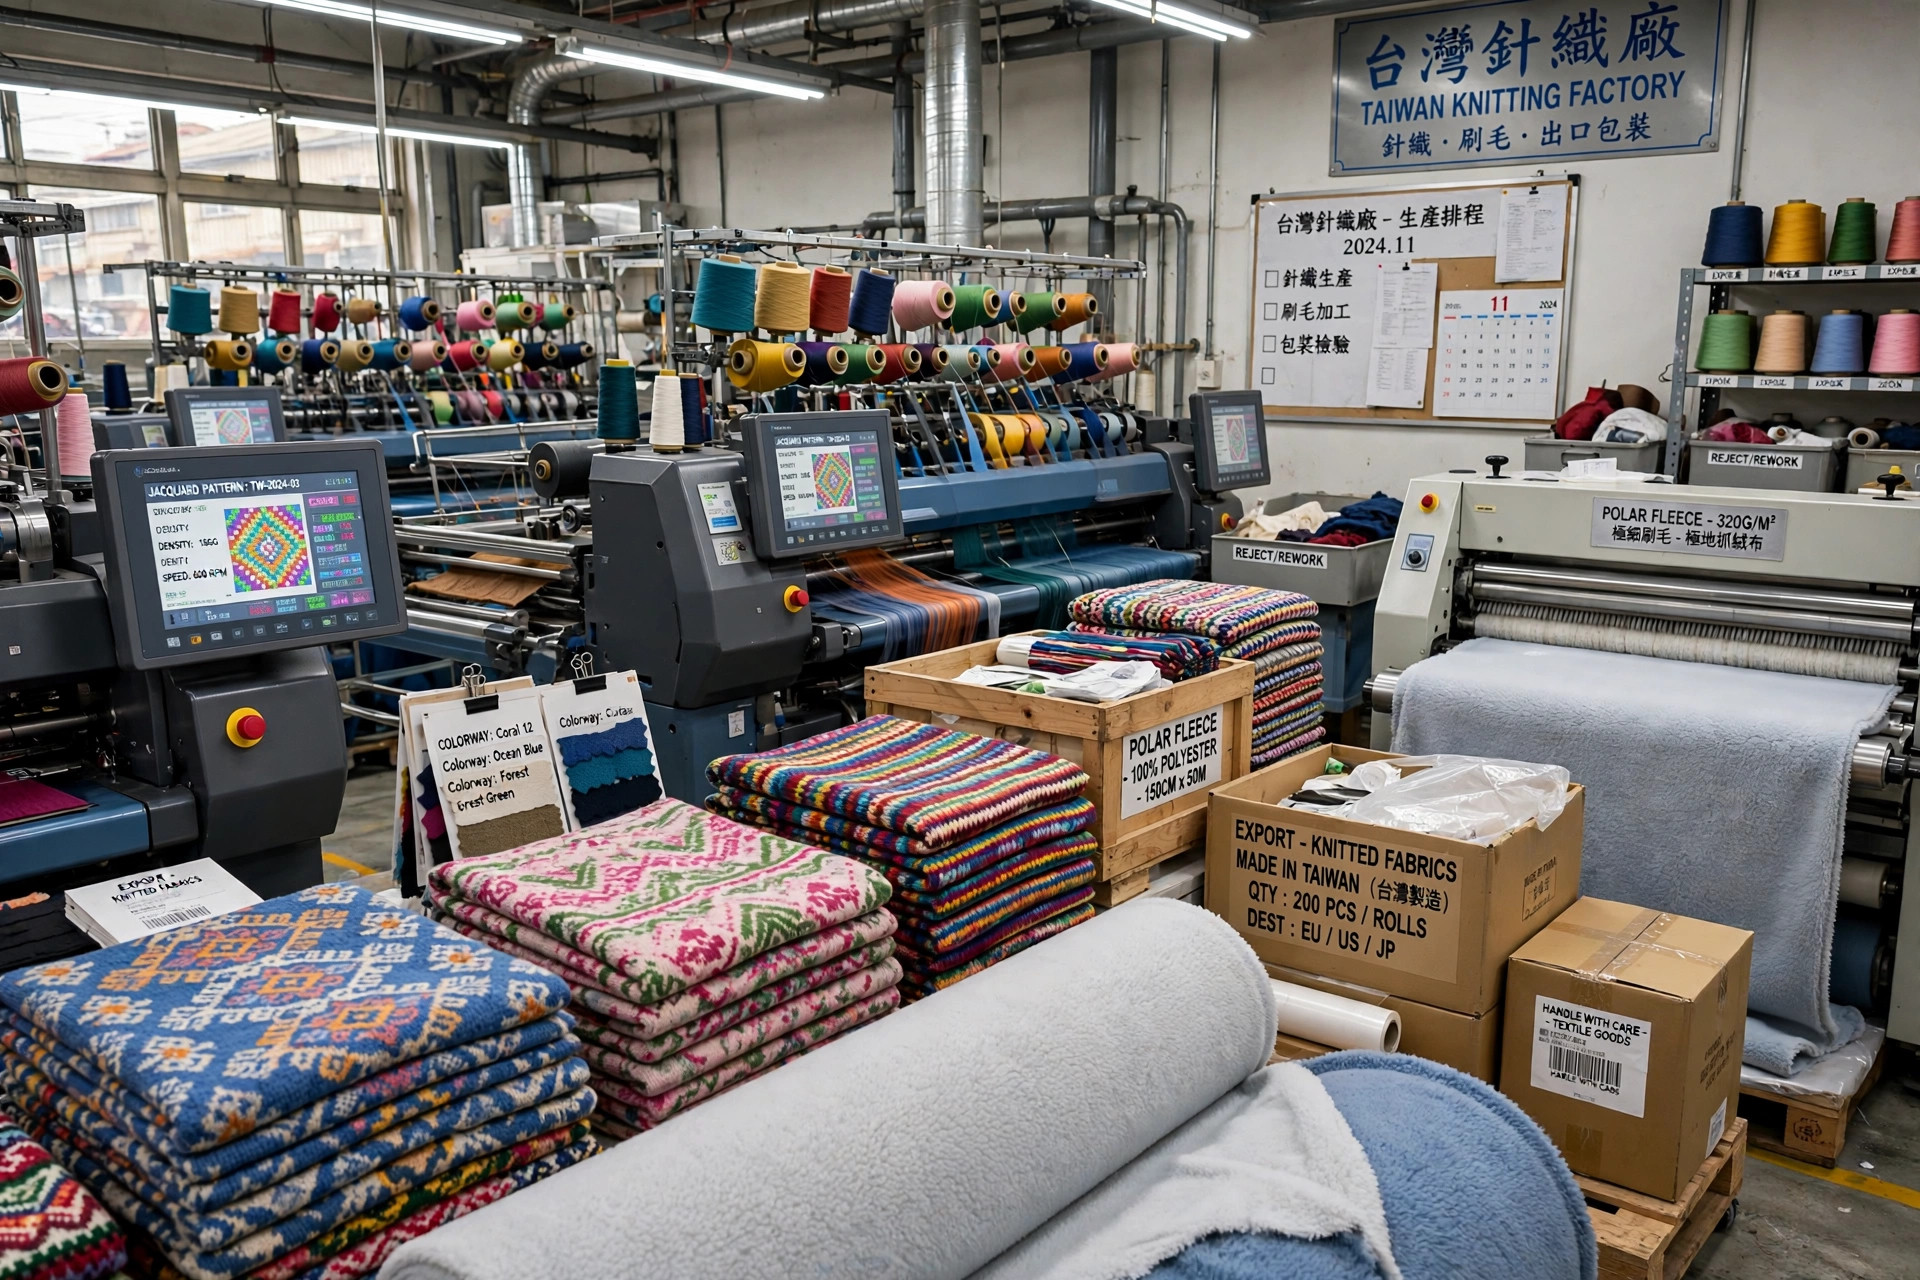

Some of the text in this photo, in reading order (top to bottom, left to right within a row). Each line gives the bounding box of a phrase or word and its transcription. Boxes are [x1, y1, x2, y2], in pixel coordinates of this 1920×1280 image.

[1365, 1, 1686, 92] 台灣針織廠
[1361, 70, 1687, 126] TAIWAN KNITTING FACTORY
[1399, 203, 1485, 229] 生產排程
[1343, 236, 1415, 255] 2024.11
[1283, 267, 1353, 289] 針織生產
[1281, 301, 1351, 322] 刷毛加工
[1491, 295, 1557, 312] 11 2024
[1280, 334, 1350, 355] 包裝檢驗
[1711, 452, 1800, 468] REJECT/REWORK
[1602, 506, 1647, 523] POLAR
[1652, 509, 1703, 527] FLEECE
[1235, 546, 1324, 567] REJECT/REWORK
[559, 712, 604, 728] Colorway:
[437, 729, 494, 752] COLORWAY:
[496, 726, 521, 740] Coral
[1129, 712, 1217, 760] POLAR FLEECE
[442, 742, 544, 773] Colorway: Ocean Blue
[1130, 757, 1158, 784] 100%
[1160, 738, 1217, 774] POLYESTER
[447, 765, 530, 794] Colorway: Forest
[1144, 775, 1177, 802] 150CM
[1186, 764, 1207, 787] 50M
[486, 788, 515, 804] Green
[1235, 818, 1296, 850] EXPORT
[1311, 834, 1379, 868] KNITTED
[1385, 848, 1458, 884] FABRICS
[1236, 847, 1278, 877] MADE
[1282, 857, 1297, 880] IN
[1302, 862, 1360, 895] TAIWAN
[1248, 880, 1278, 906] QTY
[1293, 890, 1321, 915] 200
[1325, 895, 1357, 924] PCS
[1361, 904, 1369, 925] /
[1373, 909, 1427, 940] ROLLS
[1247, 907, 1285, 936] DEST
[1301, 919, 1322, 944] EU
[1326, 926, 1334, 946] /
[1338, 929, 1360, 953] US
[1364, 935, 1373, 956] /
[1376, 938, 1396, 961] JP
[1542, 1003, 1582, 1022] HANDLE
[1584, 1012, 1610, 1029] WITH
[1612, 1021, 1641, 1037] CARE
[1552, 1018, 1592, 1038] TEXTILE
[1594, 1029, 1632, 1047] GOODS
